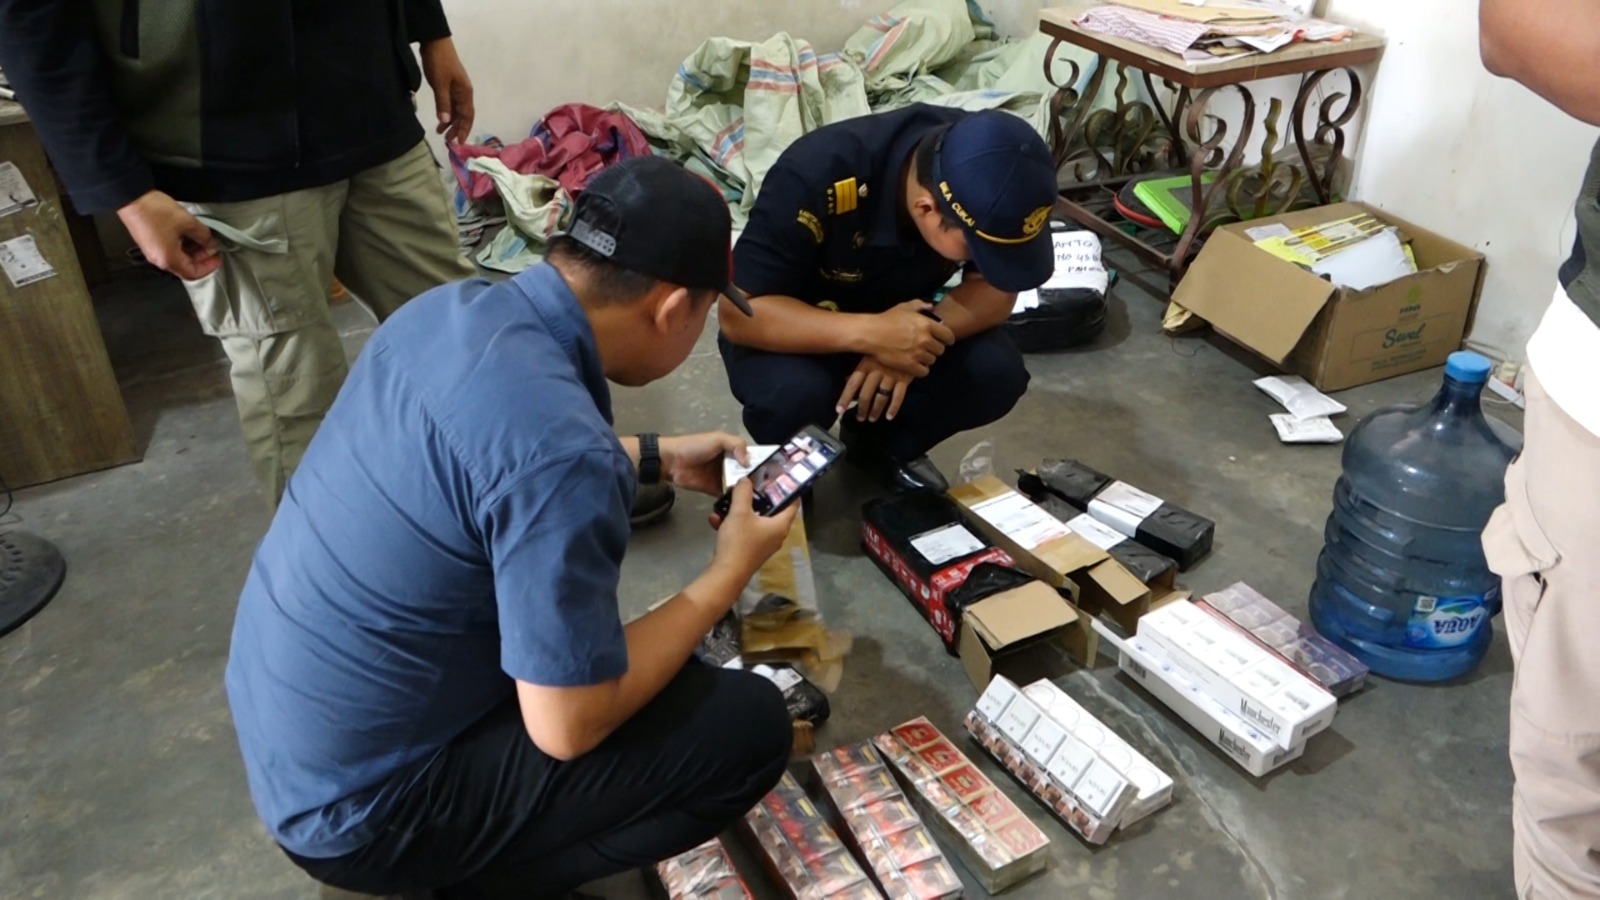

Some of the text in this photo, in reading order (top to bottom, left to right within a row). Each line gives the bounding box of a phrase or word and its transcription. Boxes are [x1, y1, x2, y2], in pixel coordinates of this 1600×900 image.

[1434, 615, 1480, 634] AQUA
[1240, 698, 1281, 735] Manchester
[1219, 728, 1252, 762] Manchester
